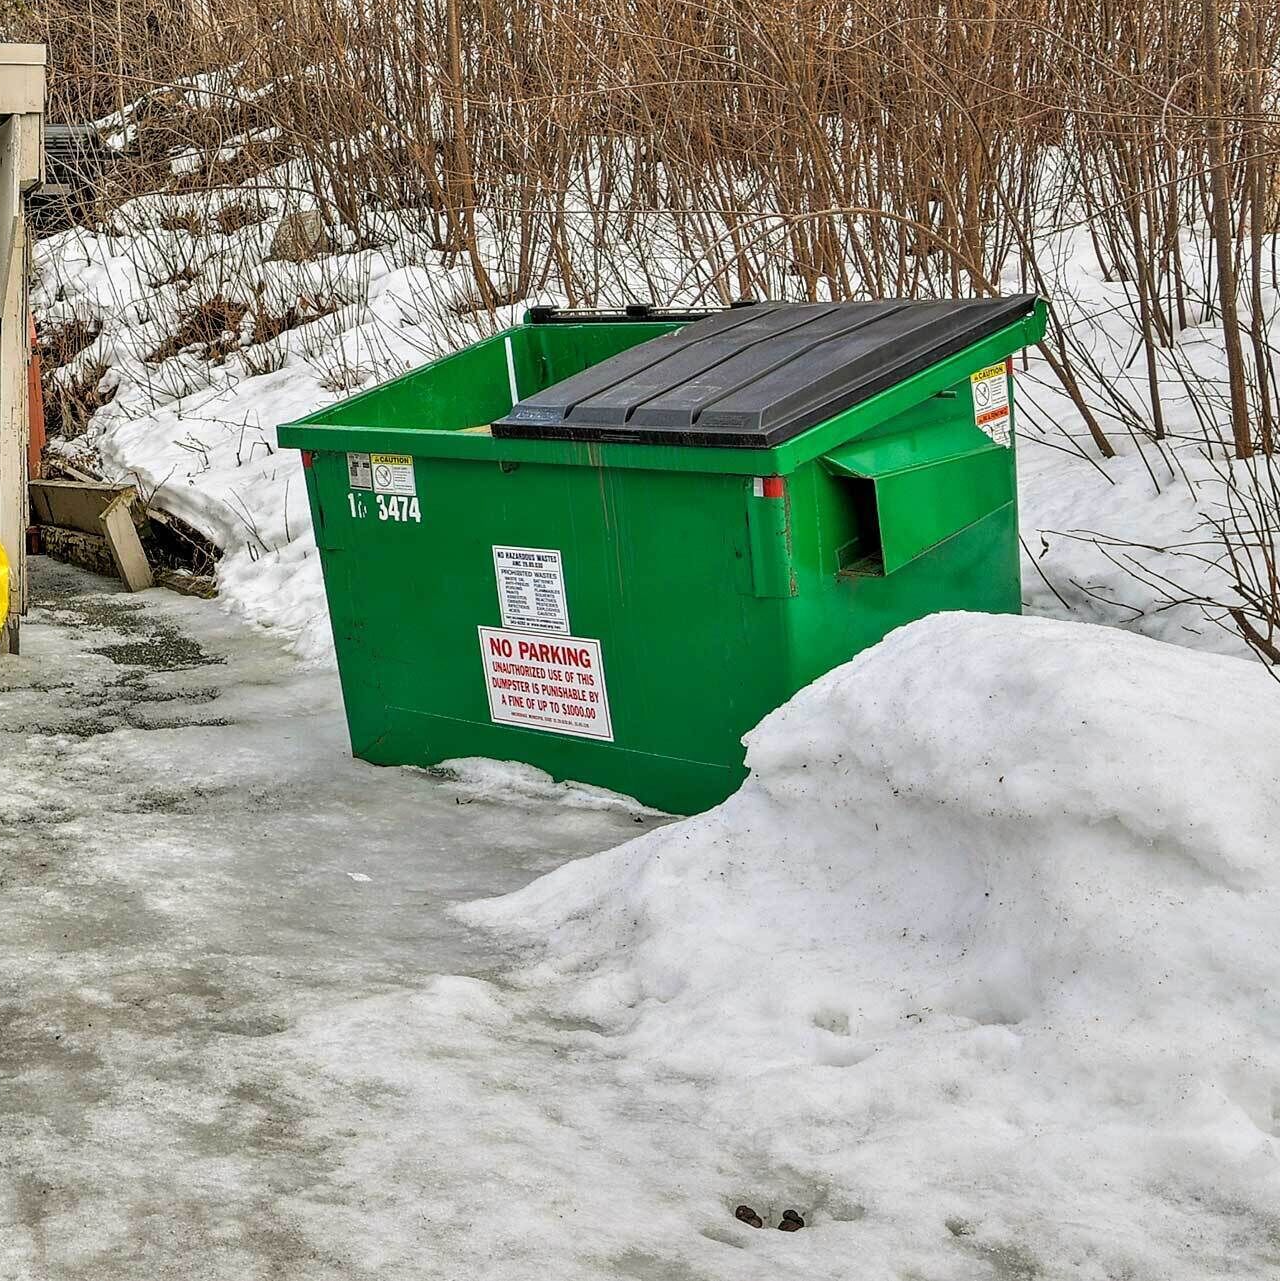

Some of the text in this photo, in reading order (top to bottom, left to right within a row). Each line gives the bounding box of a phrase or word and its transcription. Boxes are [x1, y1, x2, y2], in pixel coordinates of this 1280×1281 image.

[978, 366, 1003, 380] CAUTION
[376, 495, 421, 522] 3474
[506, 552, 535, 561] HAZARDOUS
[536, 554, 557, 563] WASTES
[501, 569, 532, 577] PROHIBITED
[489, 637, 591, 668] NO PARKING
[492, 661, 594, 686] UNAUTHORIZED USE OF THIS
[492, 677, 599, 703] DUMPSTER IS PUNISHABLE BY
[501, 694, 596, 719] A FINE OF UP TO $1000.00
